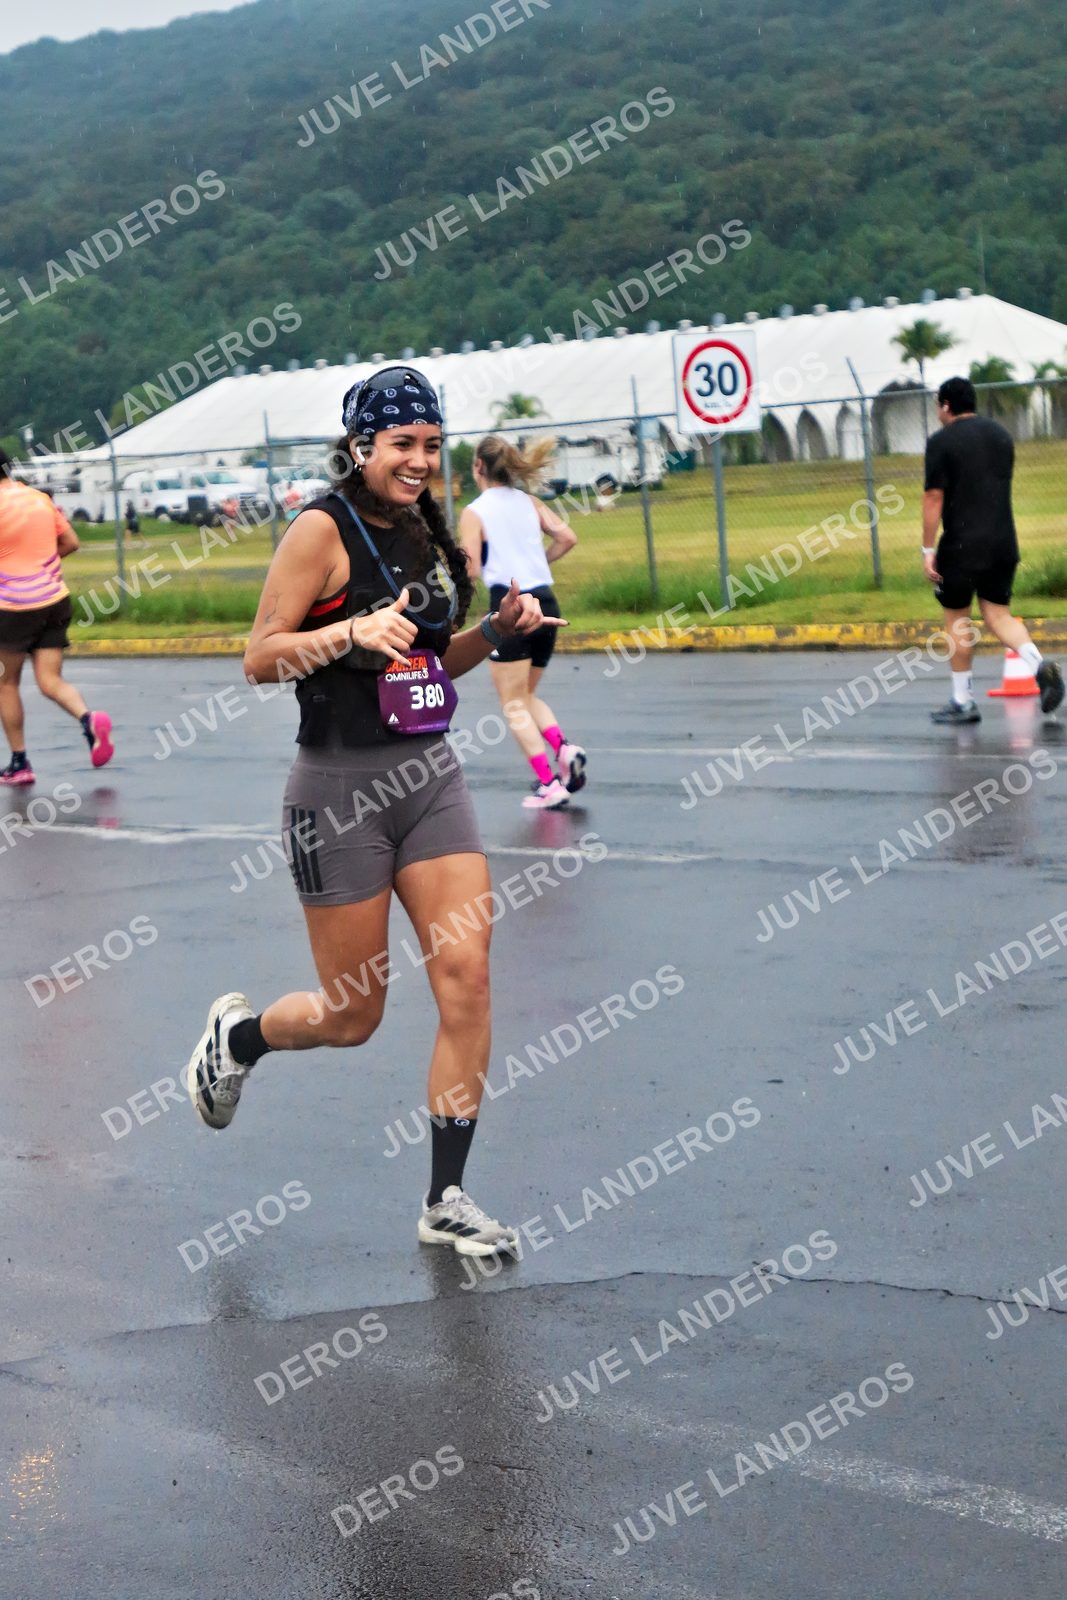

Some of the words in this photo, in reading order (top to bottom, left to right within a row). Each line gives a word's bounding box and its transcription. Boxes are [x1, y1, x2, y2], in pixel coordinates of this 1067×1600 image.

[694, 361, 738, 397] 30
[385, 670, 422, 682] OMNILIFE
[409, 683, 445, 710] 380
